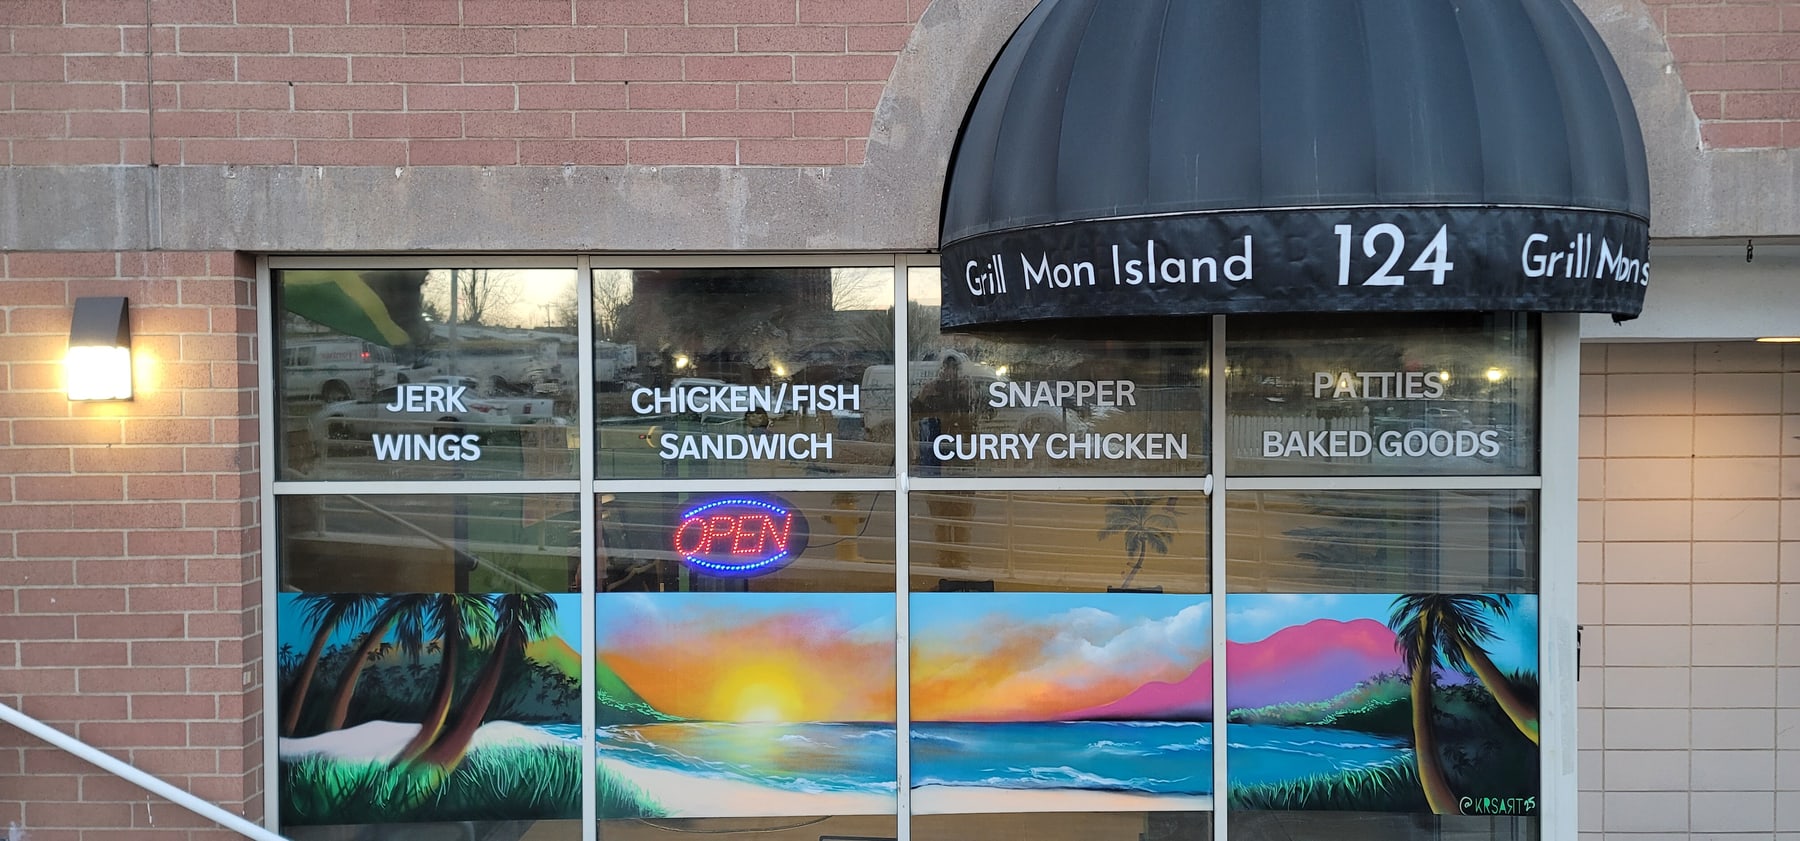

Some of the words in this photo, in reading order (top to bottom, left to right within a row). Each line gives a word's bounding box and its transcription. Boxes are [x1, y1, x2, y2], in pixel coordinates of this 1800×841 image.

[965, 253, 1006, 296] Grill
[1020, 251, 1095, 290] Mon
[1112, 235, 1252, 285] Island
[1334, 223, 1454, 286] 124
[1522, 233, 1591, 278] Grill
[386, 385, 467, 412] JERK
[988, 380, 1136, 407] SNAPPER
[1314, 371, 1444, 399] PATTIES
[372, 434, 480, 461] WINGS
[659, 433, 833, 460] SANDWICH
[933, 433, 1041, 460] CURRY
[1046, 433, 1188, 460] CHICKEN
[1263, 430, 1372, 457] BAKED
[1379, 430, 1500, 457] GOODS
[674, 513, 792, 556] OPEN
